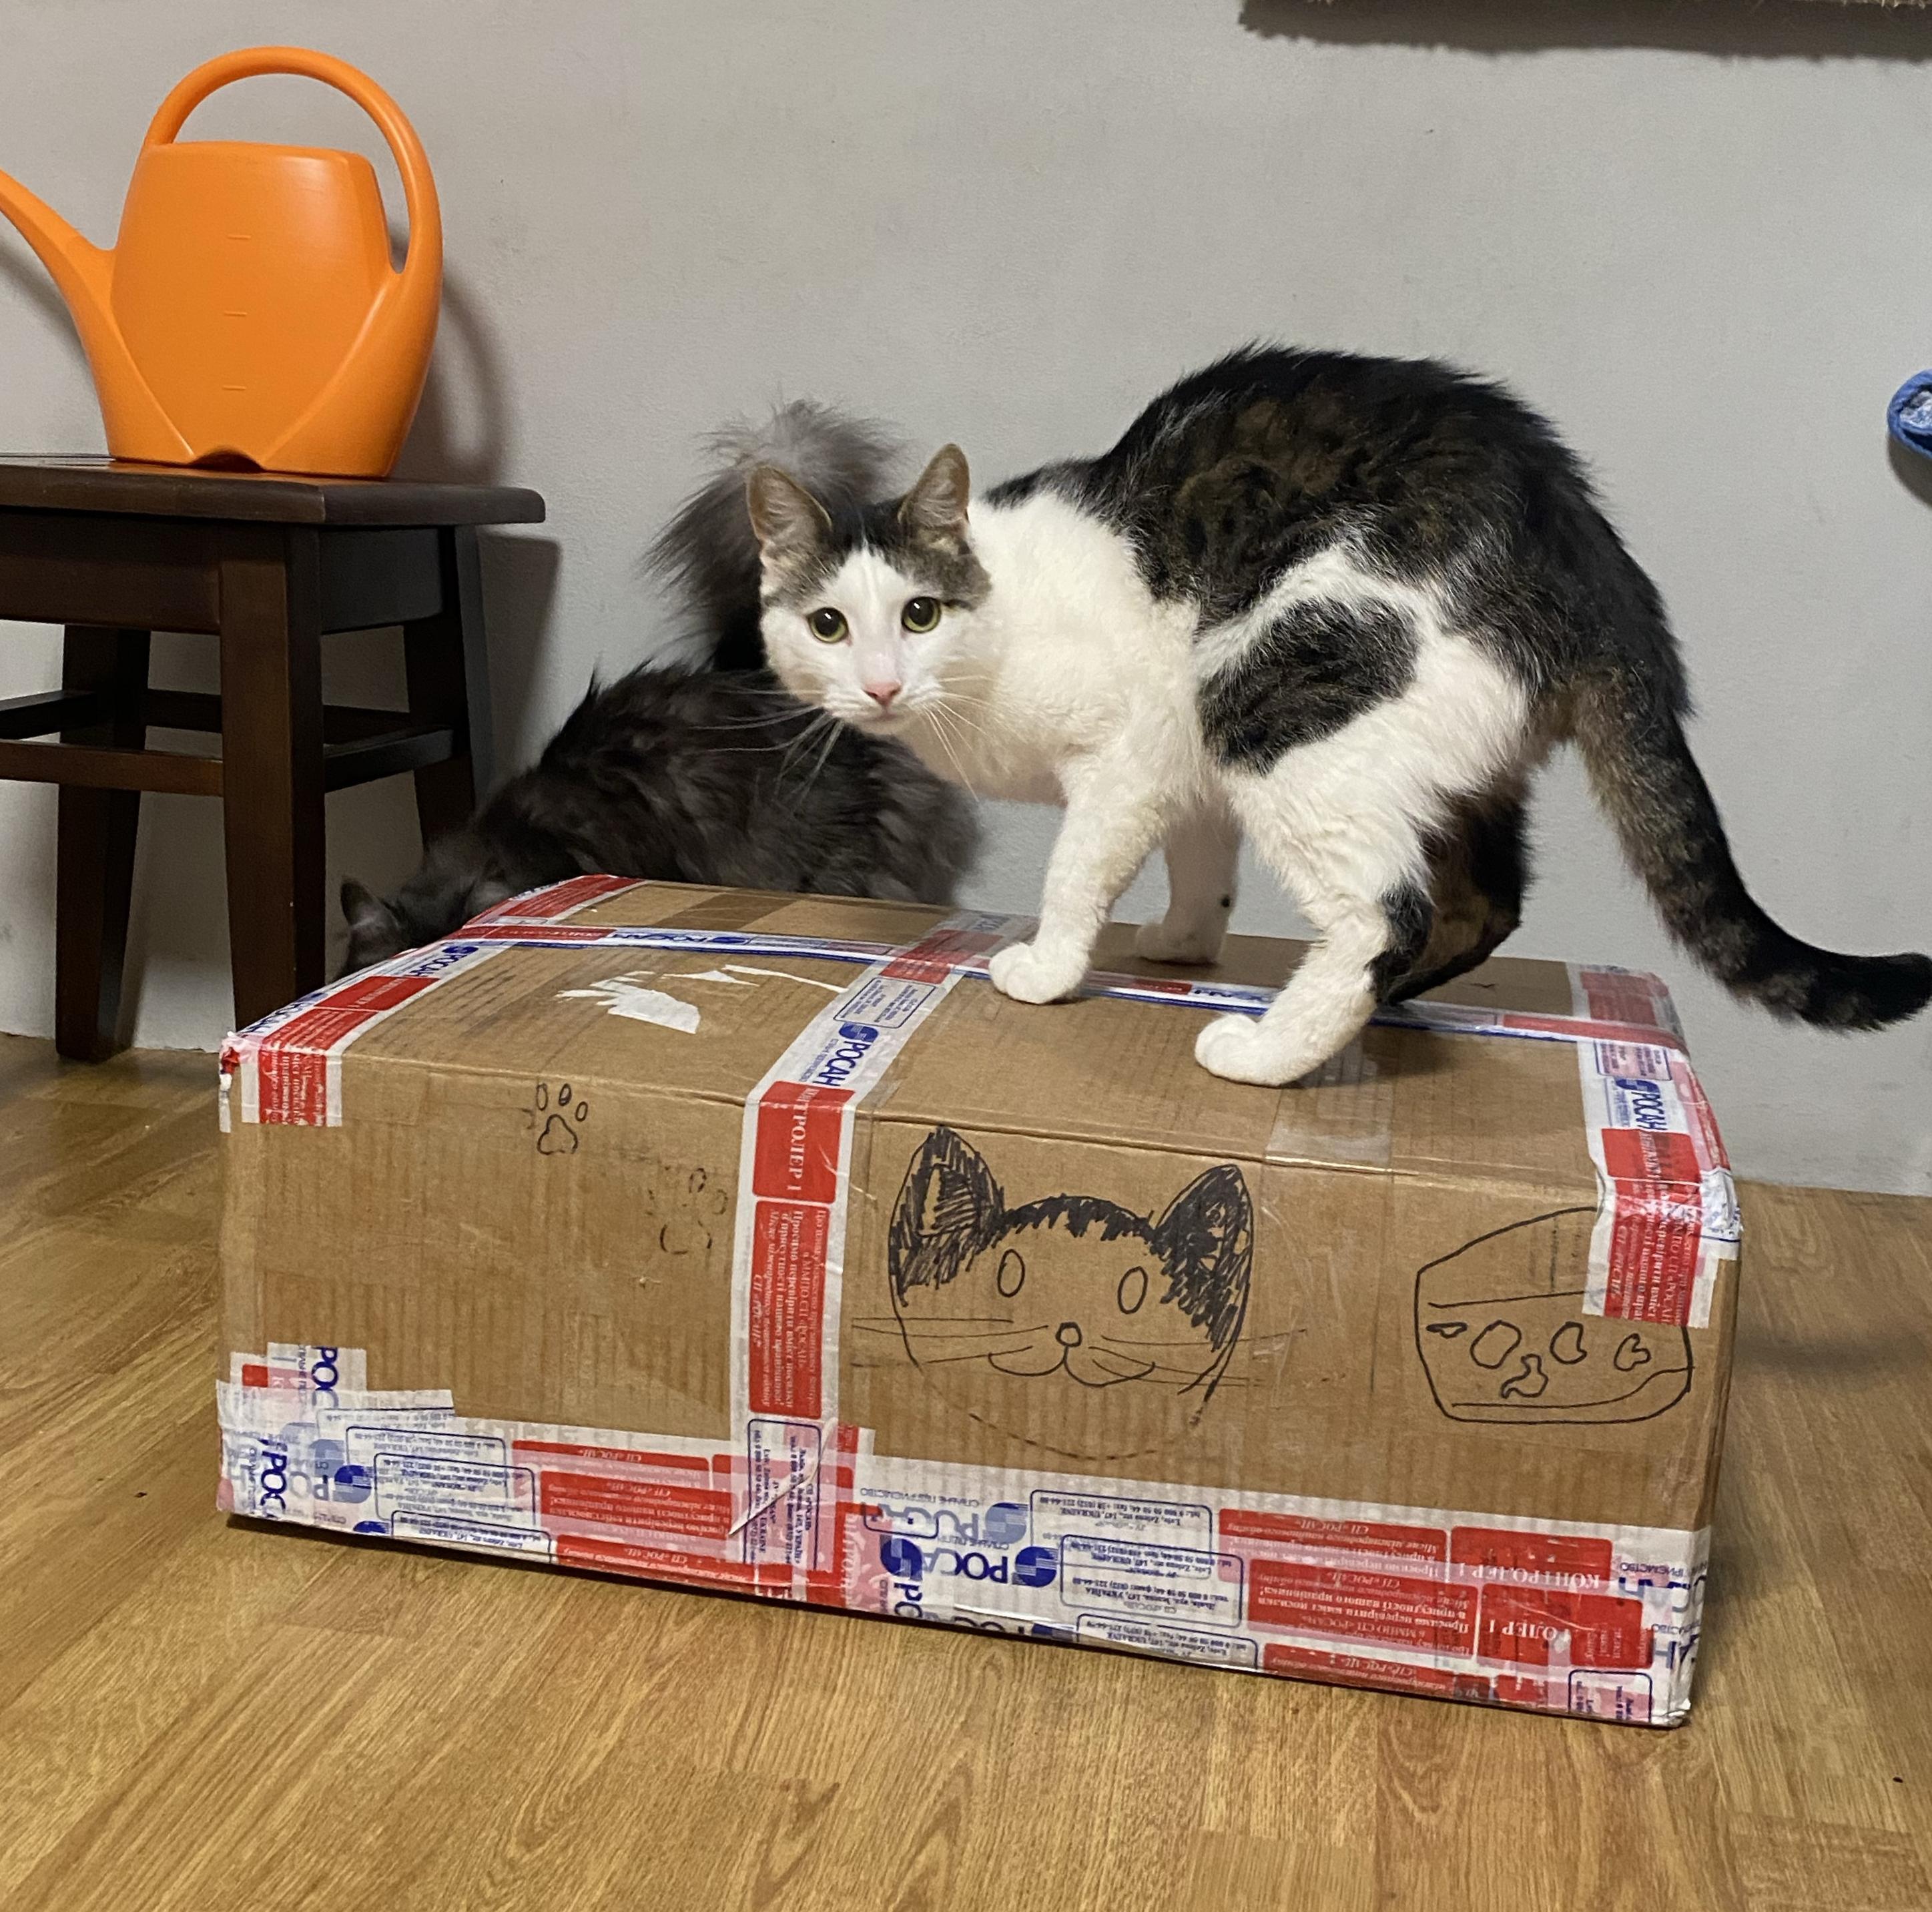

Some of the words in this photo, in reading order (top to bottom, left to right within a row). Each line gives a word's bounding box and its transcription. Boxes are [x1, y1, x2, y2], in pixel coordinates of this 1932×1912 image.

[812, 1041, 872, 1087] РОСАН
[1631, 1085, 1668, 1131] РОСАН
[921, 1548, 1008, 1584] РОСА
[1472, 1564, 1600, 1590] КОНТРОЛЕР
